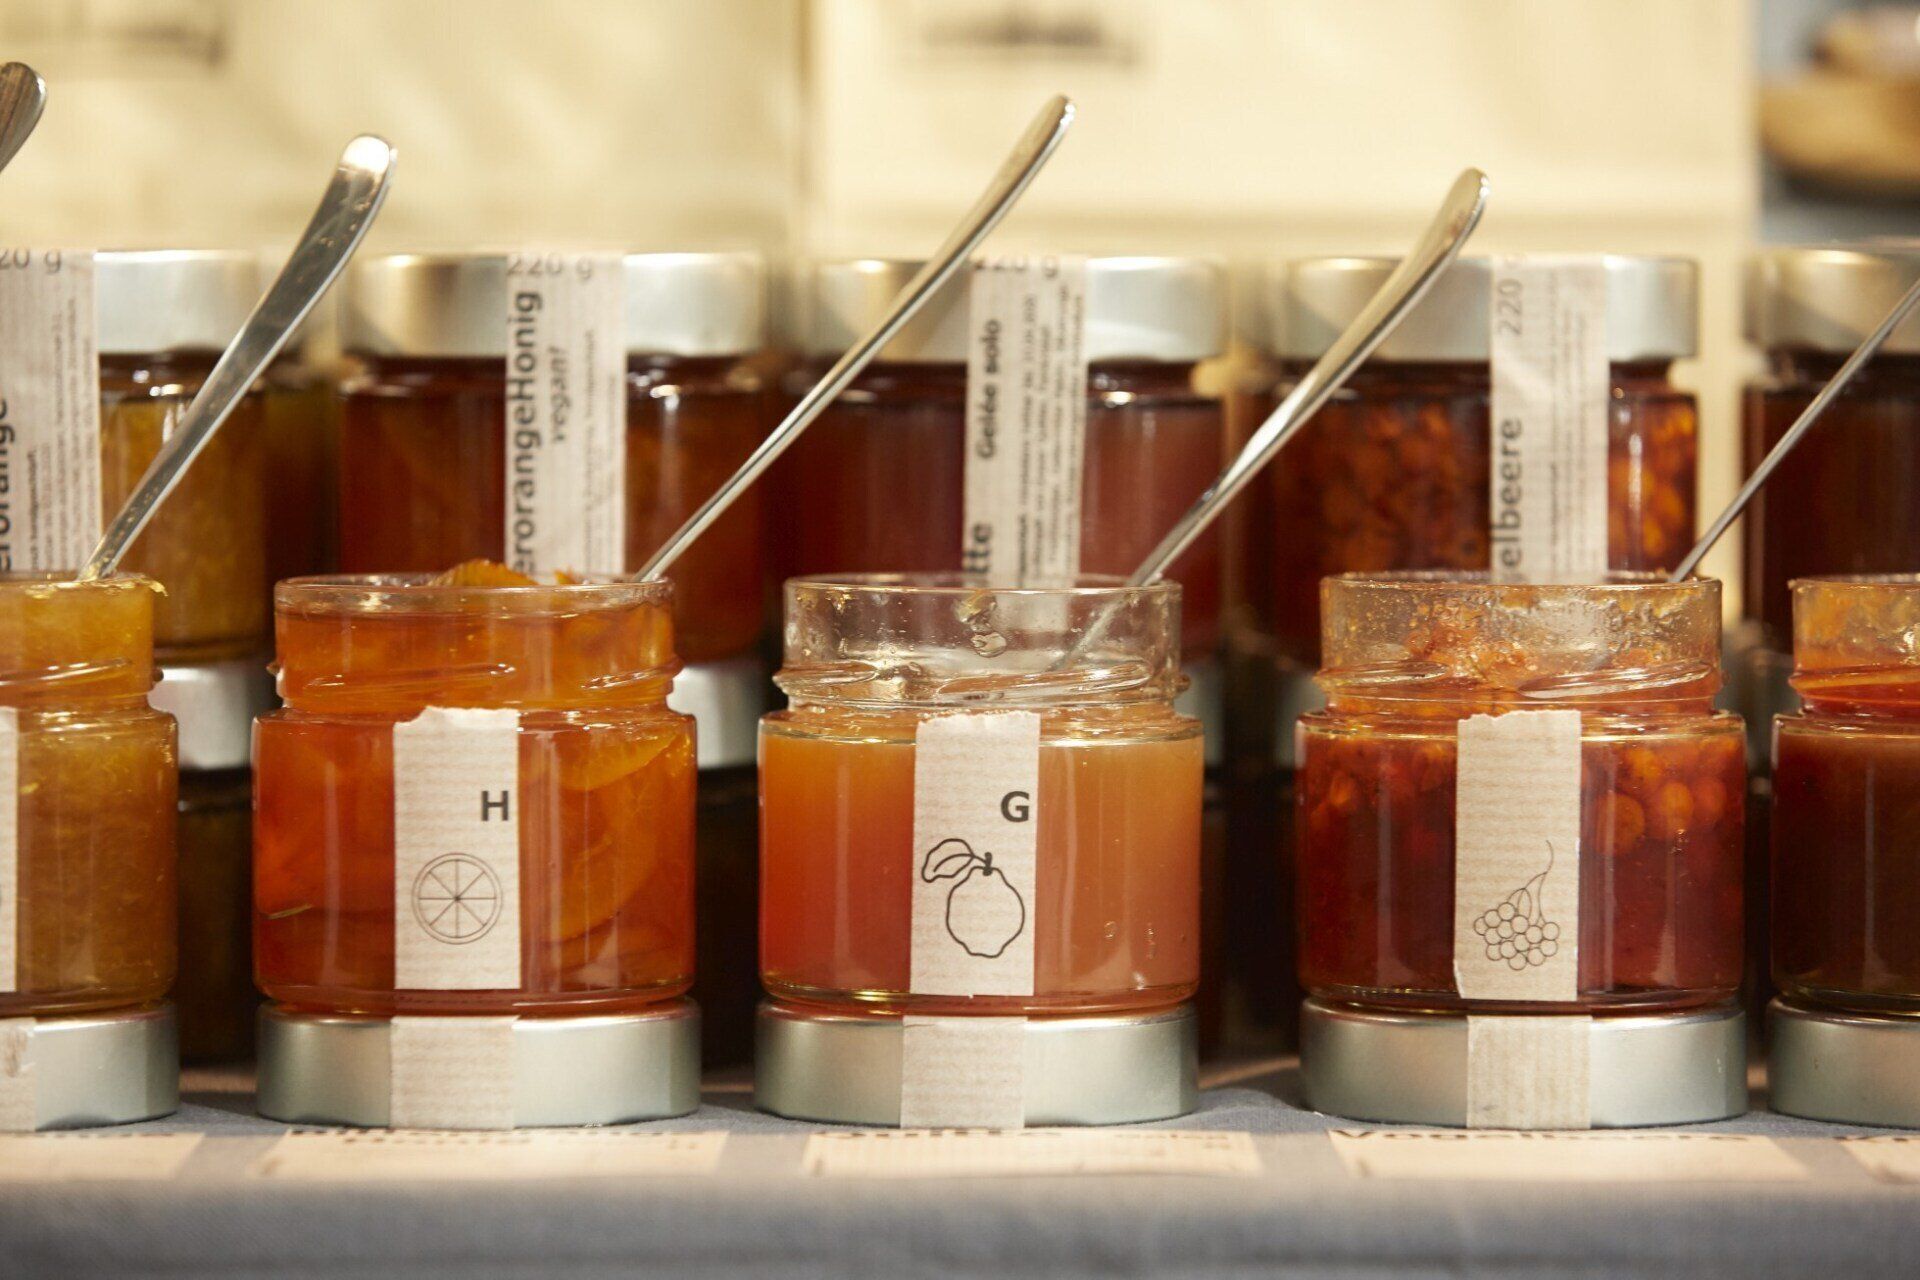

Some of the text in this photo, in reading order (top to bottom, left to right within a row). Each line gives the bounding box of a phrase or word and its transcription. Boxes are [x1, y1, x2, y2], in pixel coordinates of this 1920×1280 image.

[44, 250, 62, 274] g
[1497, 278, 1522, 335] 220
[507, 290, 542, 573] erorangeHonig
[962, 319, 1001, 578] tte Gelée solo
[480, 790, 510, 822] H
[1000, 791, 1031, 822] G
